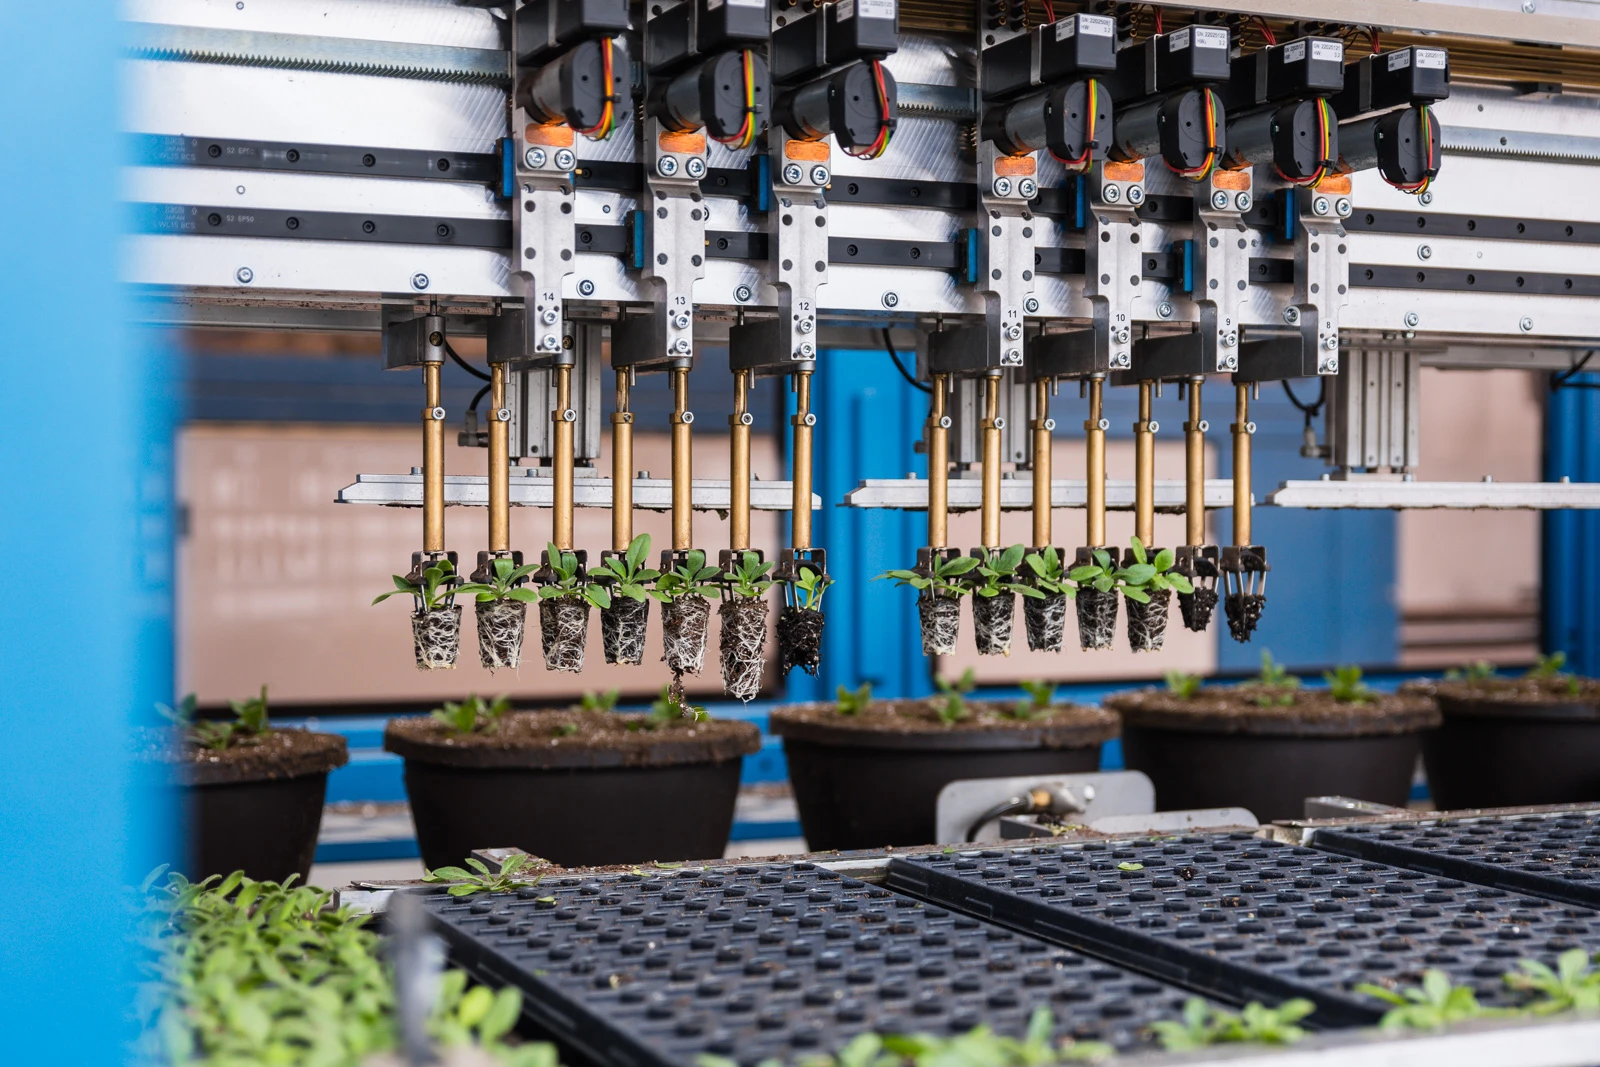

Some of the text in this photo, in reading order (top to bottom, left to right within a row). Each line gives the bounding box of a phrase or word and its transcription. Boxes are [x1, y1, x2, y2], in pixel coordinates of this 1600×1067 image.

[226, 214, 234, 222] S2
[542, 292, 555, 301] 14
[675, 296, 686, 305] 13
[798, 302, 809, 311] 12
[1007, 310, 1017, 318] 11
[1115, 313, 1126, 322] 10
[1225, 318, 1231, 326] 9
[1326, 321, 1331, 329] 8
